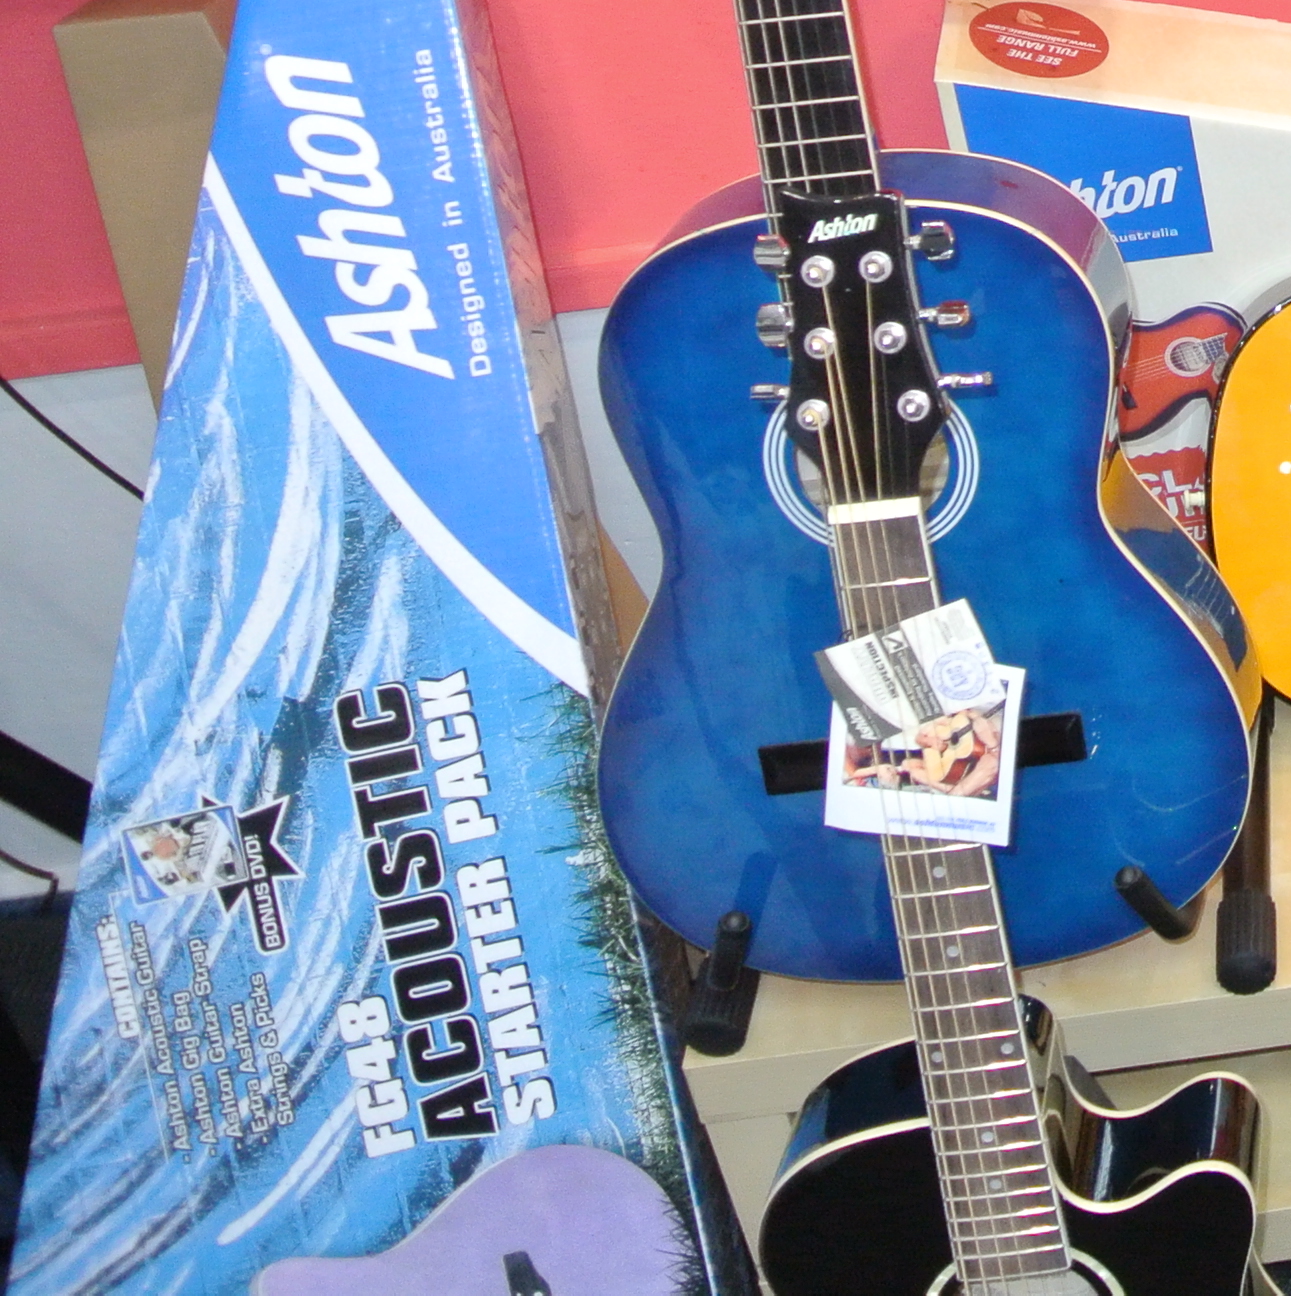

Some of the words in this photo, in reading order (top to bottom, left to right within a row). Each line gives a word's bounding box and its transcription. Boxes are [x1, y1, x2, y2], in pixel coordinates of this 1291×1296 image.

[996, 35, 1046, 51] RANGE
[1007, 48, 1034, 62] THE
[1034, 54, 1063, 66] SEE
[1047, 44, 1079, 57] FULL
[413, 49, 455, 183] Australia
[263, 55, 455, 380] Ashton
[442, 199, 463, 227] in
[807, 213, 878, 243] Ashton
[454, 240, 492, 377] Designed
[864, 640, 899, 699] INSPECTION
[416, 668, 500, 845] PACK
[846, 707, 878, 741] Ashton
[243, 834, 267, 880] DVD!
[253, 882, 282, 949] BONUS
[334, 682, 500, 1142] ACOUSTIC
[95, 914, 140, 1040] CONTAINS:
[128, 920, 155, 986] Guitar
[188, 938, 214, 999] Strap
[172, 990, 192, 1033] Bag
[250, 971, 275, 1028] Picks
[456, 854, 558, 1127] STARTER
[143, 987, 175, 1075] Acoustic
[181, 1035, 201, 1070] Gig
[202, 1000, 227, 1065] Guitar
[230, 1002, 258, 1074] Ashton
[259, 1028, 279, 1048] &
[190, 1072, 219, 1145] Ashton
[216, 1067, 244, 1138] Ashton
[246, 1078, 270, 1134] Extra
[267, 1051, 295, 1126] Strings
[337, 995, 418, 1159] FG48
[163, 1079, 192, 1150] Ashton
